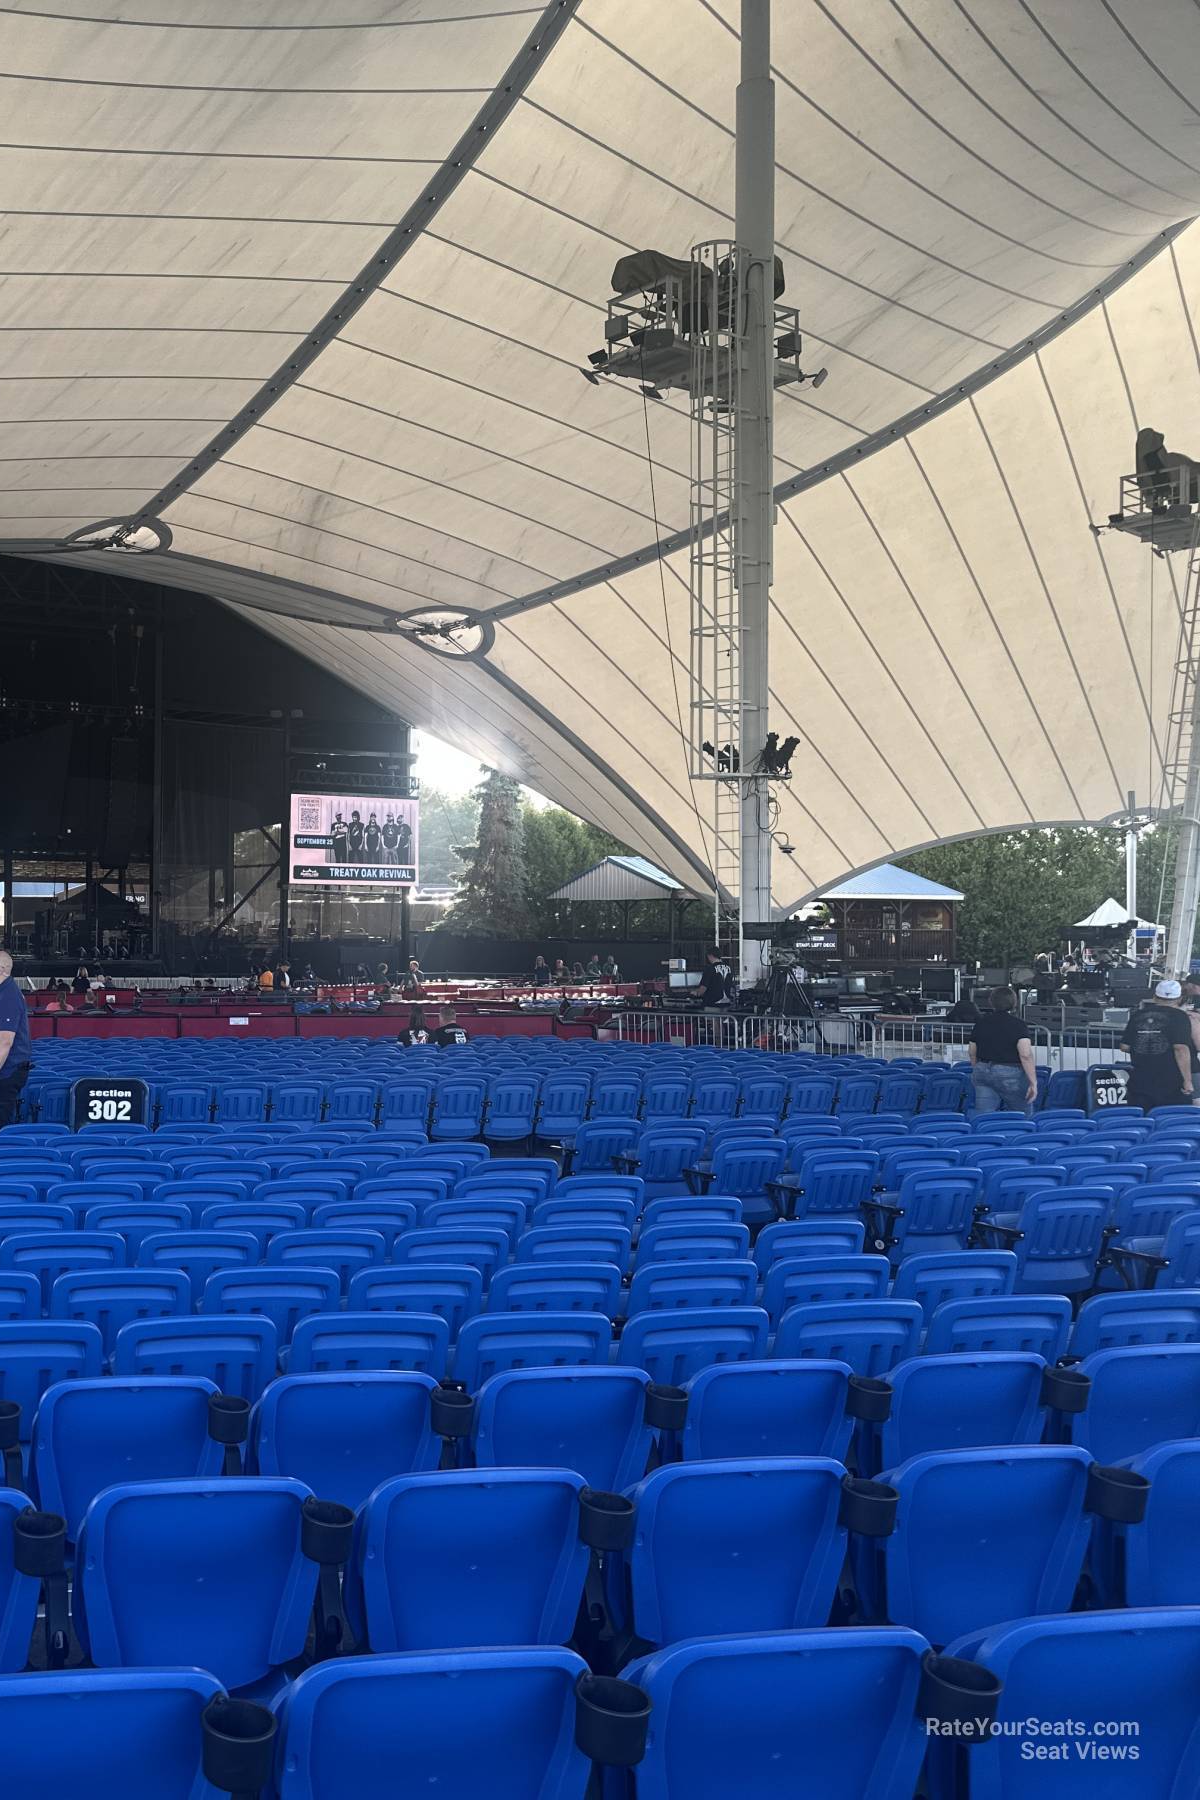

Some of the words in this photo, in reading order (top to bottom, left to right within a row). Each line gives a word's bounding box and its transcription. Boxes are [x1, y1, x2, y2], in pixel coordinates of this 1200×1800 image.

[296, 837, 326, 845] SEPTEMBER
[329, 867, 360, 877] TREATY
[361, 868, 378, 878] OAK
[378, 869, 411, 879] REVIVAL
[89, 1089, 132, 1097] section
[1096, 1086, 1128, 1105] 302
[88, 1099, 132, 1120] 302
